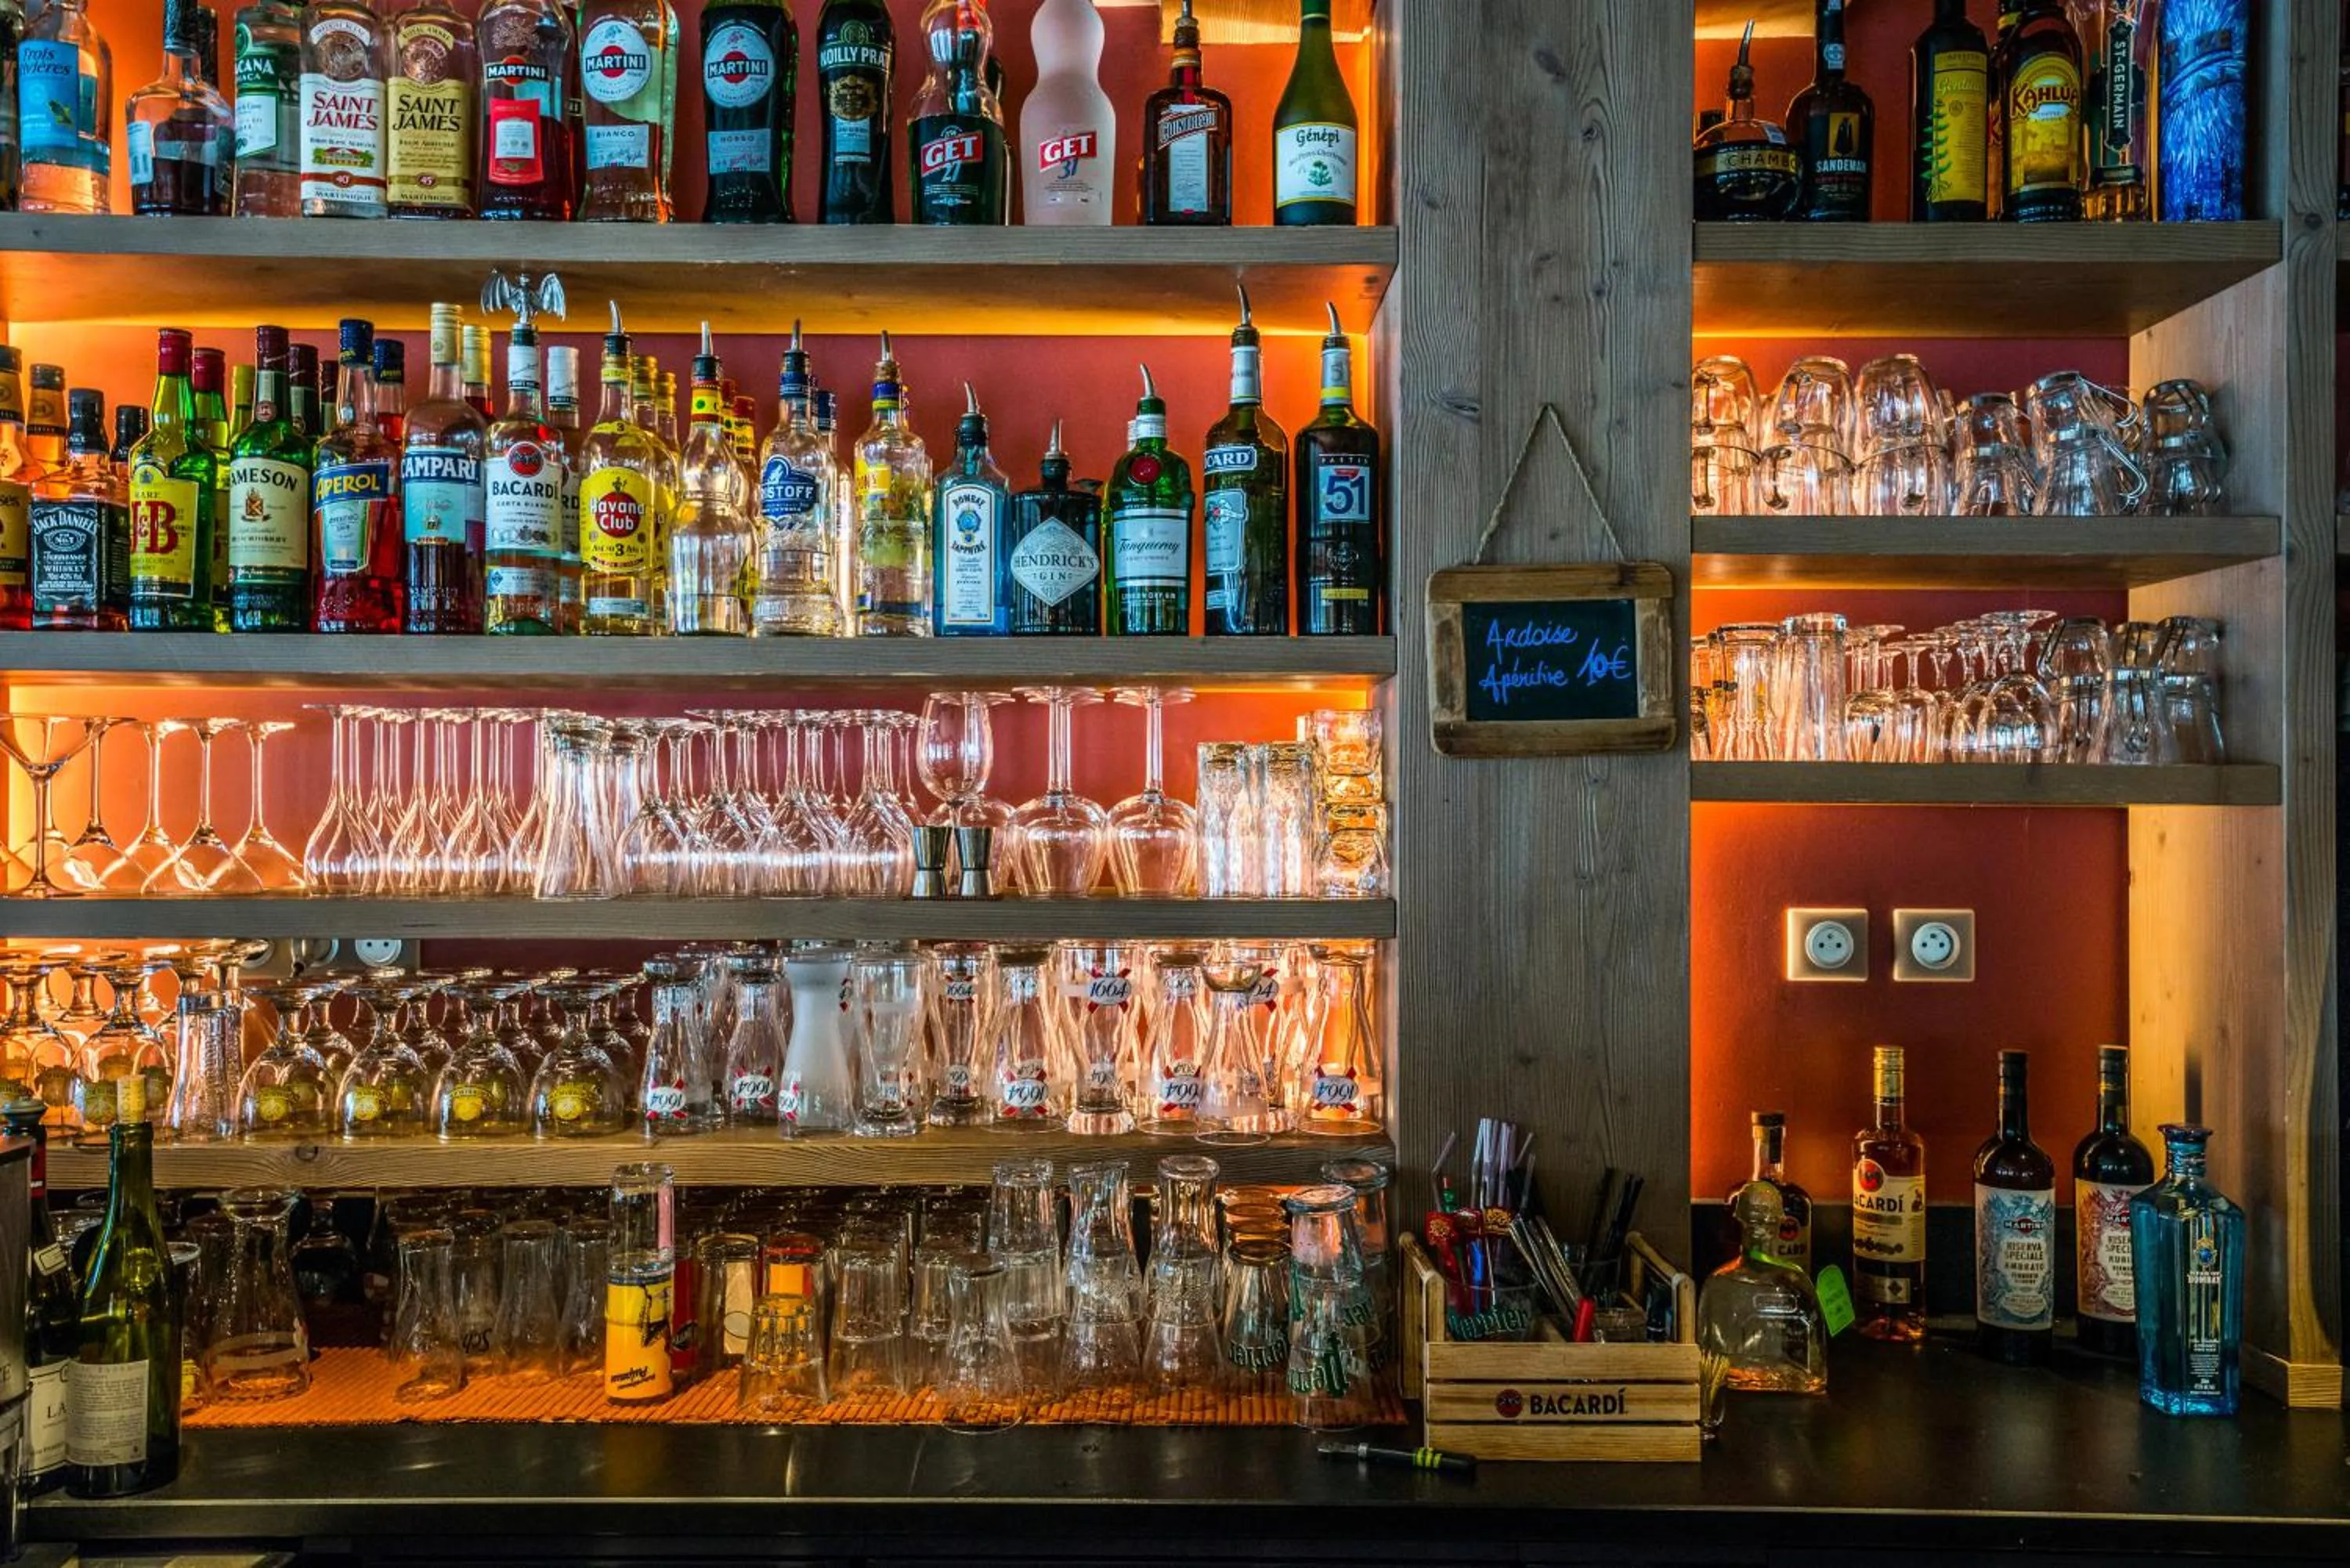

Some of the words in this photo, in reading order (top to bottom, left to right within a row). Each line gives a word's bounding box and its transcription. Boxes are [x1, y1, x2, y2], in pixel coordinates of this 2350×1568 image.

[588, 55, 645, 70] MARTINI
[708, 61, 765, 77] MARTINI
[488, 65, 546, 78] MARTINI
[2113, 41, 2126, 128] ST-GERMAIN
[313, 92, 377, 114] SAINT
[397, 94, 460, 114] SAINT
[306, 114, 378, 131] JAMES
[392, 116, 461, 132] JAMES
[1296, 128, 1340, 147] Génépi
[926, 135, 978, 166] GET
[1044, 135, 1093, 162] GET
[942, 159, 963, 182] 27
[1058, 159, 1078, 180] 31
[401, 456, 478, 481] CAMPARI
[316, 473, 381, 502] APEROL
[492, 479, 559, 500] BACARDÍ
[1325, 475, 1365, 515] 51
[591, 497, 645, 514] Havana
[952, 493, 986, 509] BOMBAY
[34, 514, 58, 535] JACK
[599, 513, 634, 530] Club
[615, 543, 624, 557] 3
[951, 540, 987, 556] SAPPHIRE
[1119, 538, 1180, 555] Tanqueray
[44, 565, 87, 573] WHISKEY
[1014, 554, 1095, 569] HENDRICK'S
[1039, 571, 1067, 581] GIN
[1485, 618, 1578, 665] Ardoise
[1577, 637, 1632, 687] 10€
[947, 984, 973, 996] 1664
[1090, 981, 1130, 997] 1664
[738, 1079, 771, 1095] 1664
[1008, 1086, 1045, 1102] 1664
[1165, 1082, 1198, 1099] 664
[1318, 1082, 1355, 1098] 1664
[650, 1093, 683, 1108] 1664
[2006, 1241, 2042, 1251] RISERVA
[2004, 1251, 2044, 1260] SPECIALE
[1529, 1386, 1628, 1415] BACARDÍ
